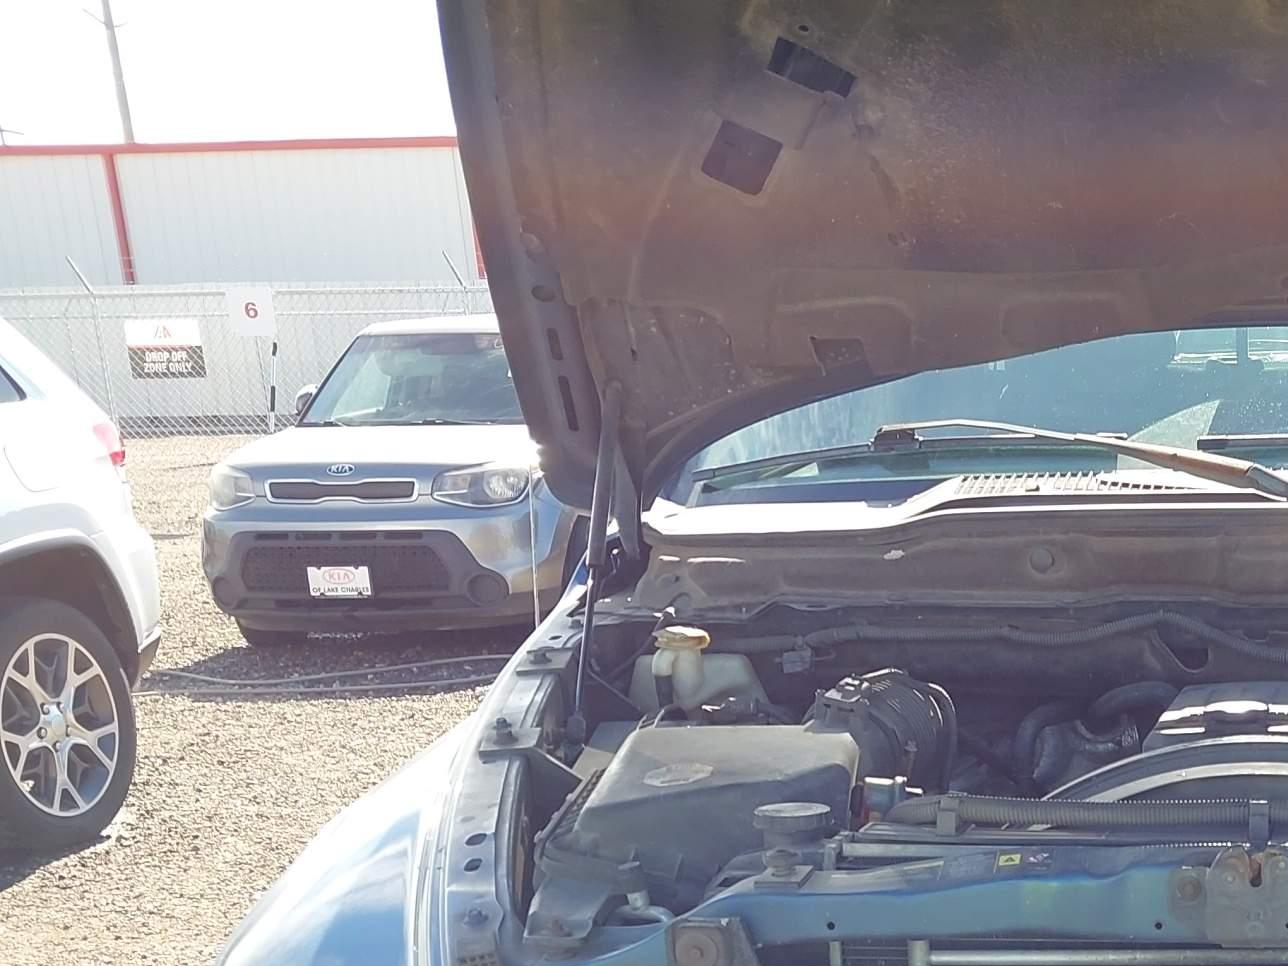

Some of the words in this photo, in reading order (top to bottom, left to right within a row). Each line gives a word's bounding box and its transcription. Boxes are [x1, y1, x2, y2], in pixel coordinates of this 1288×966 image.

[244, 302, 258, 319] 6
[145, 352, 170, 362] DROP
[172, 351, 188, 361] OFF
[144, 362, 168, 373] ZONE
[169, 362, 193, 373] ONLY
[330, 463, 351, 474] KIA
[329, 571, 351, 581] KIA
